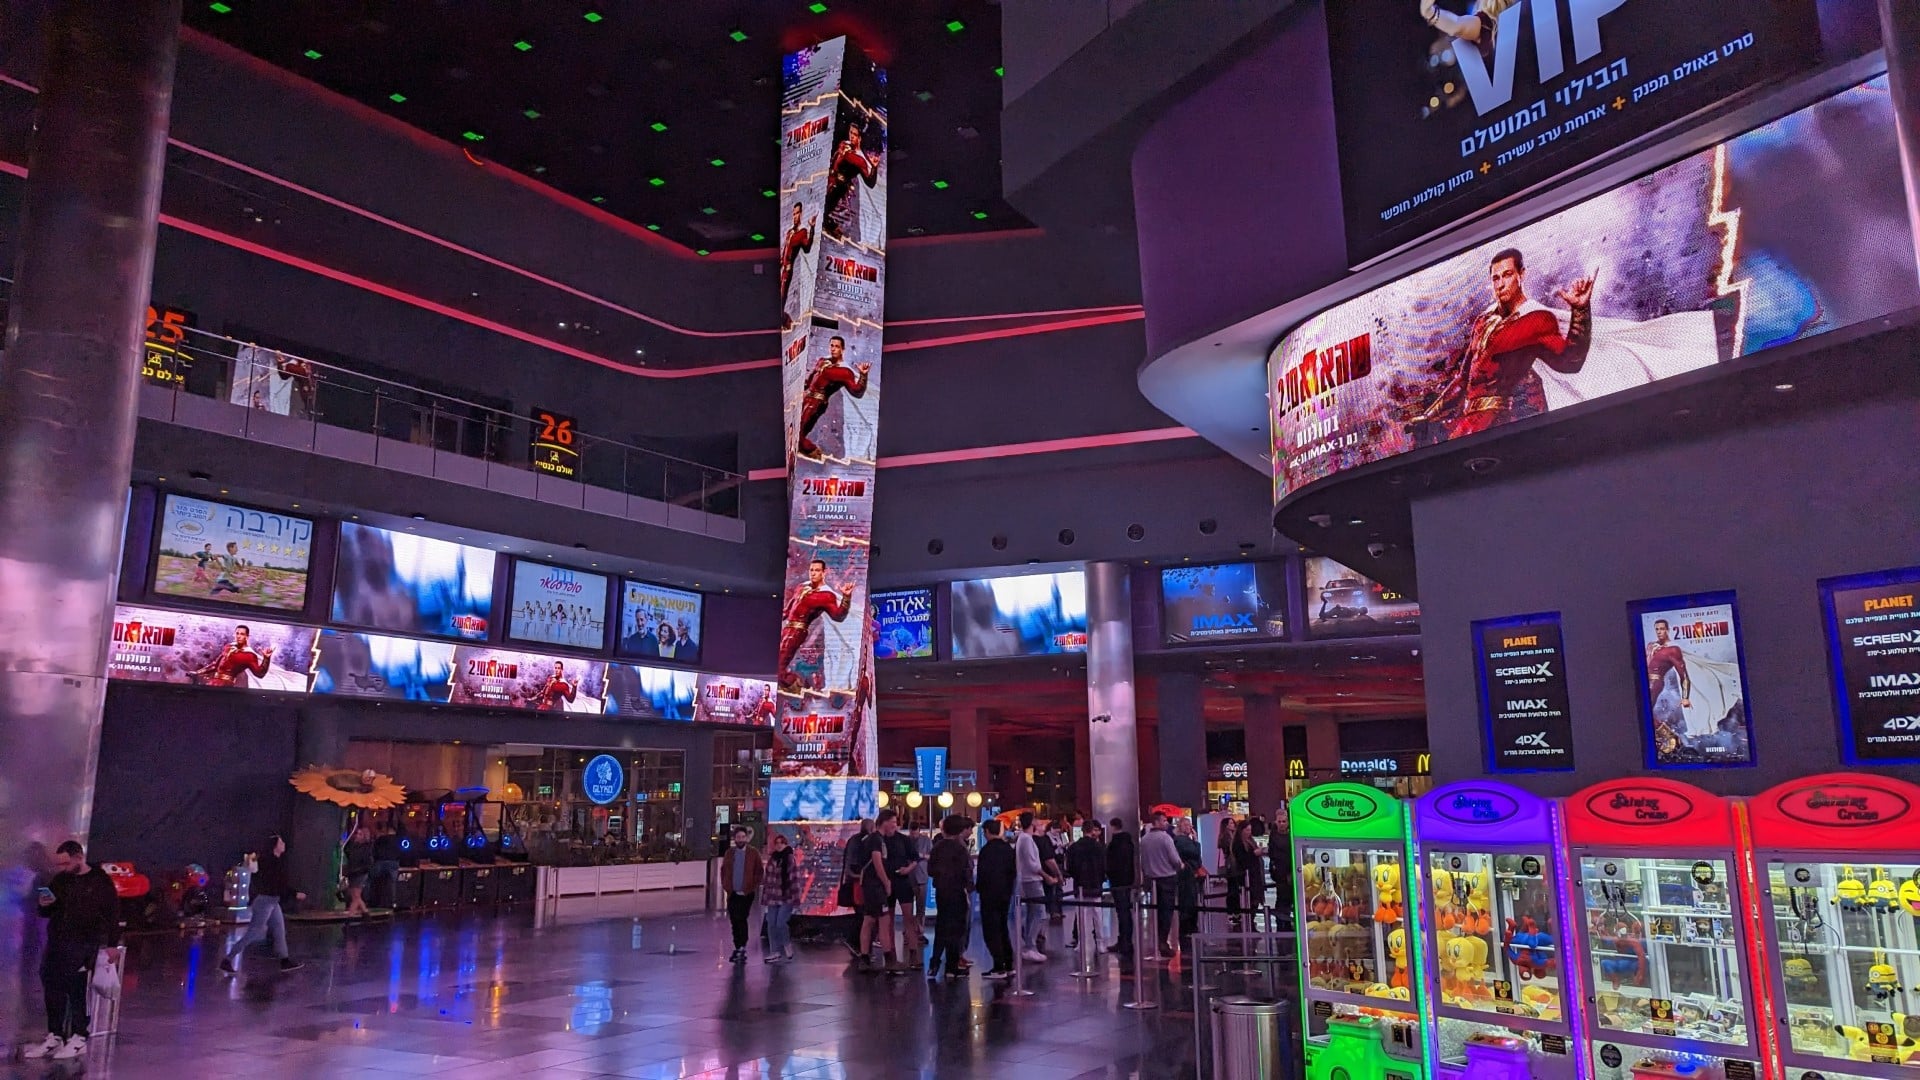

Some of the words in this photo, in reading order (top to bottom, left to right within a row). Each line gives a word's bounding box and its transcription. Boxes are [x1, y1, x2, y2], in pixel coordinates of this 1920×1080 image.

[1722, 32, 1754, 57] סרט
[1673, 50, 1719, 81] באולם
[1555, 56, 1629, 107] הבילוי
[1632, 74, 1669, 103] מפנק
[1460, 99, 1548, 158] המושלם
[1564, 104, 1607, 134] ארוחת
[1538, 126, 1561, 147] ערב
[1497, 139, 1535, 166] עשירה
[1449, 169, 1474, 192] מזנון
[1413, 183, 1446, 208] קולנוע
[1380, 199, 1411, 221] חופשי
[145, 306, 185, 344] 25
[540, 414, 572, 445] 26
[556, 464, 574, 476] אולם
[227, 507, 311, 545] קירבה
[886, 595, 926, 616] אגדה
[1864, 595, 1914, 612] PLANET
[1193, 613, 1254, 629] IMAX
[1503, 635, 1538, 648] PLANET
[1507, 699, 1548, 710] IMAX
[1515, 731, 1550, 748] 4DX
